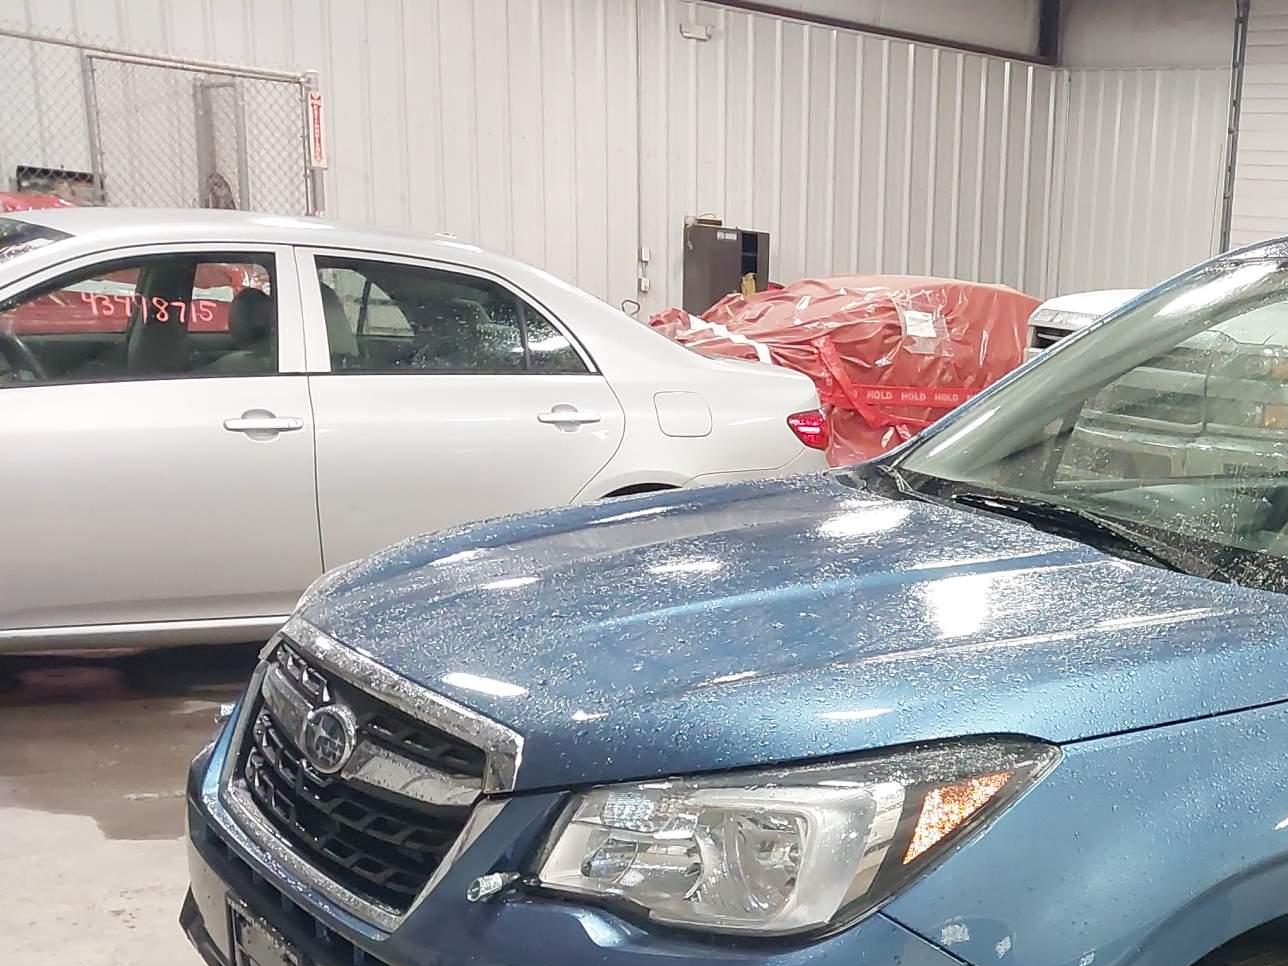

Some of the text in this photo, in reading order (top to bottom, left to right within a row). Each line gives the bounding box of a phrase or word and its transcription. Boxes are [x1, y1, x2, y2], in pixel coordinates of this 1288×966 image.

[866, 390, 893, 400] HOLD
[901, 392, 927, 401] HOLD
[934, 393, 959, 401] HOLD
